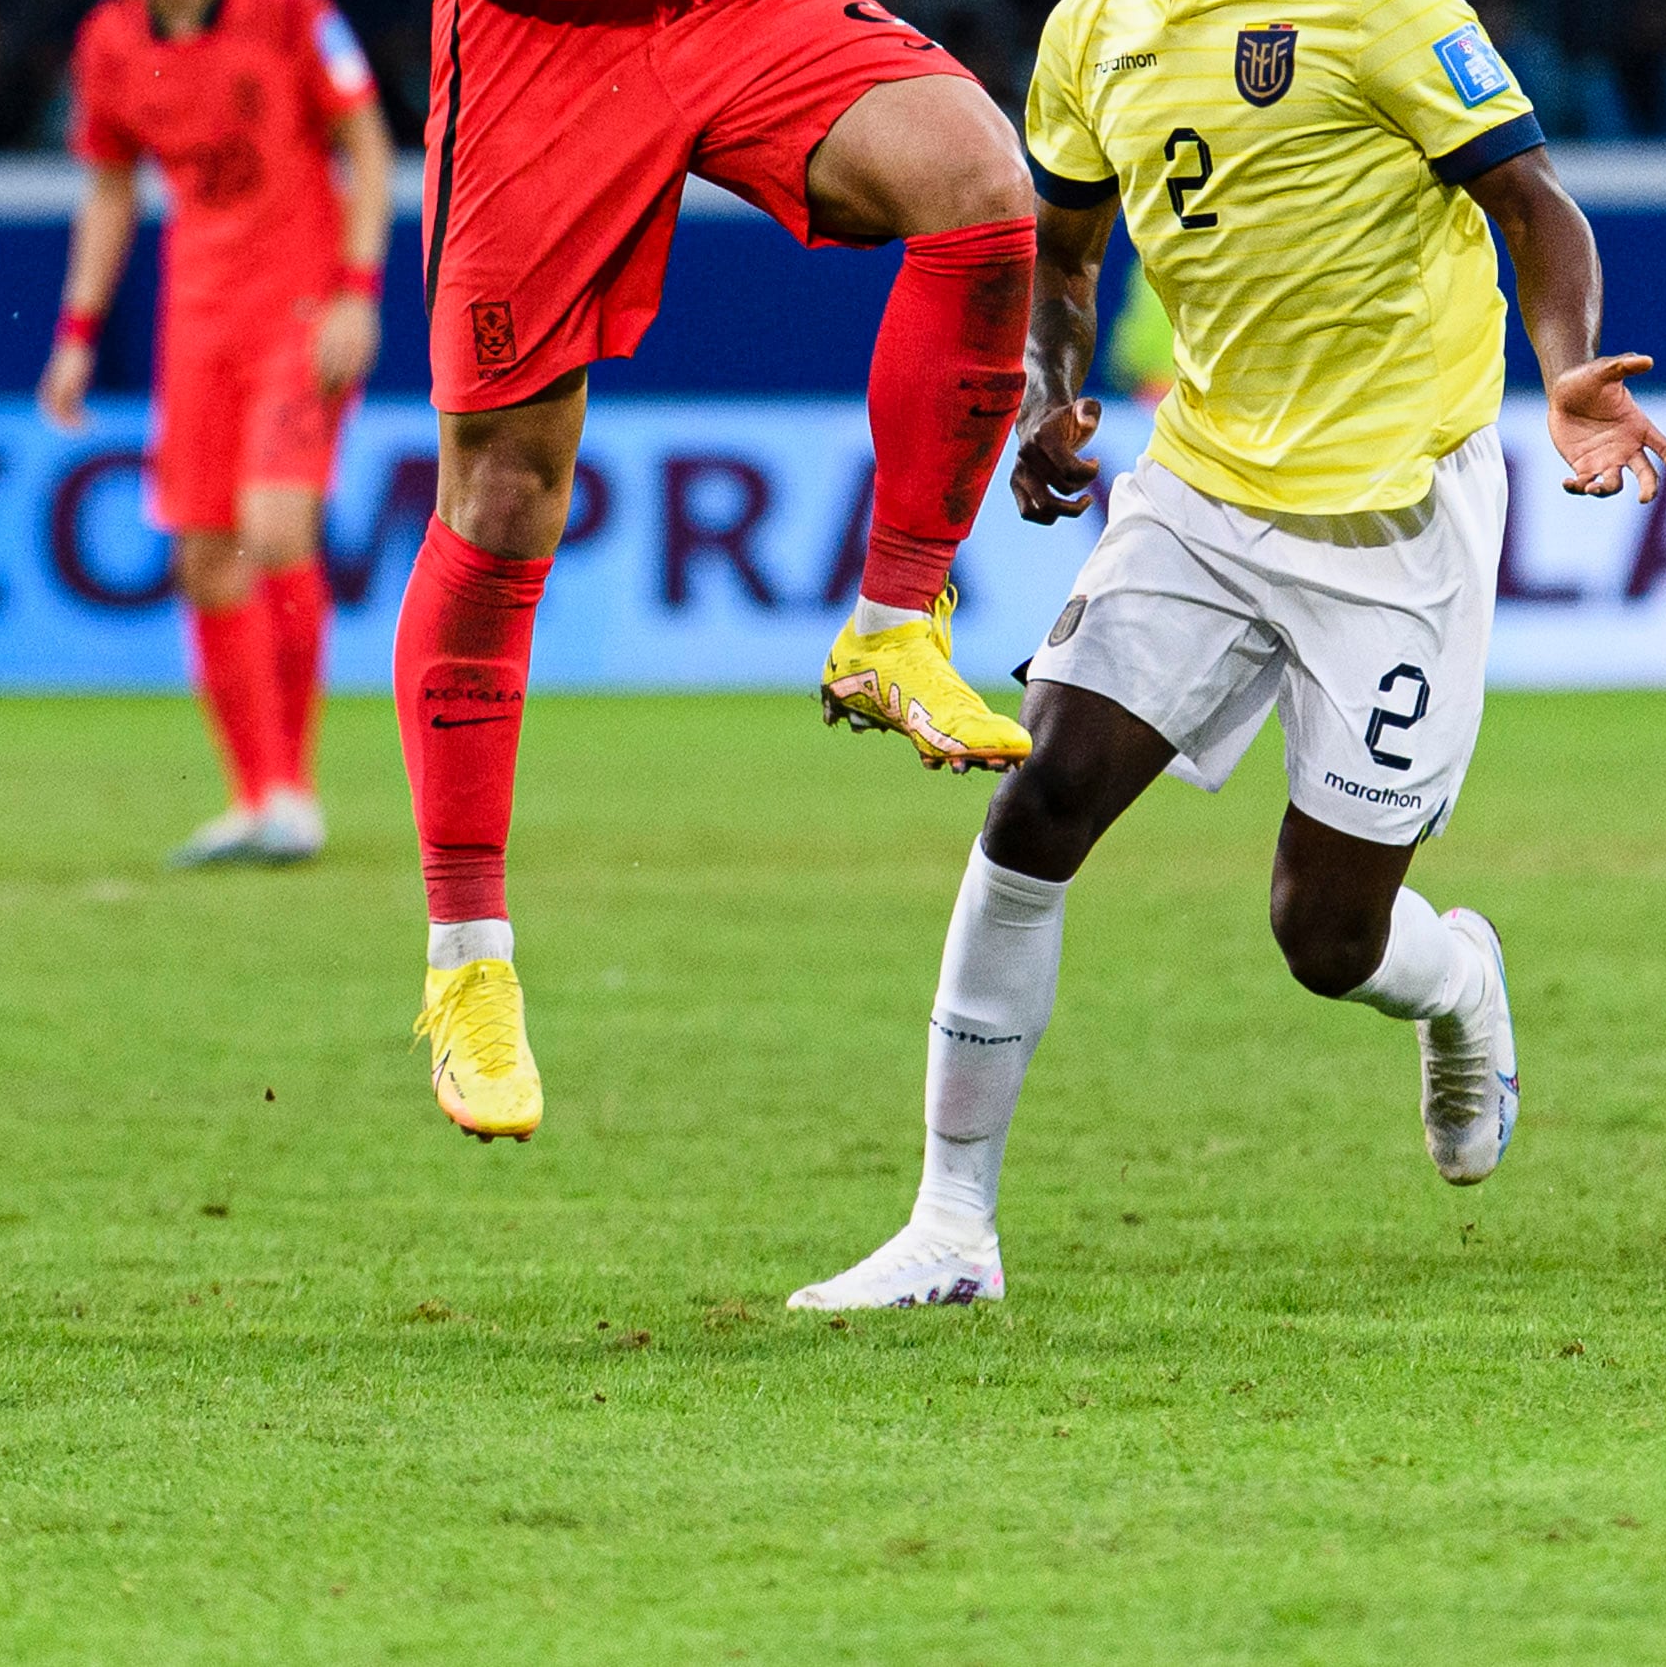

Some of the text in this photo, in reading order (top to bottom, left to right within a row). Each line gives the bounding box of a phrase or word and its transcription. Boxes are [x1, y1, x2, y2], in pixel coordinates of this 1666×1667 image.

[1163, 127, 1218, 230] 2
[425, 688, 522, 703] KOREA
[1365, 662, 1430, 771] 2
[1324, 771, 1422, 809] marathon
[930, 1017, 1022, 1045] athon
